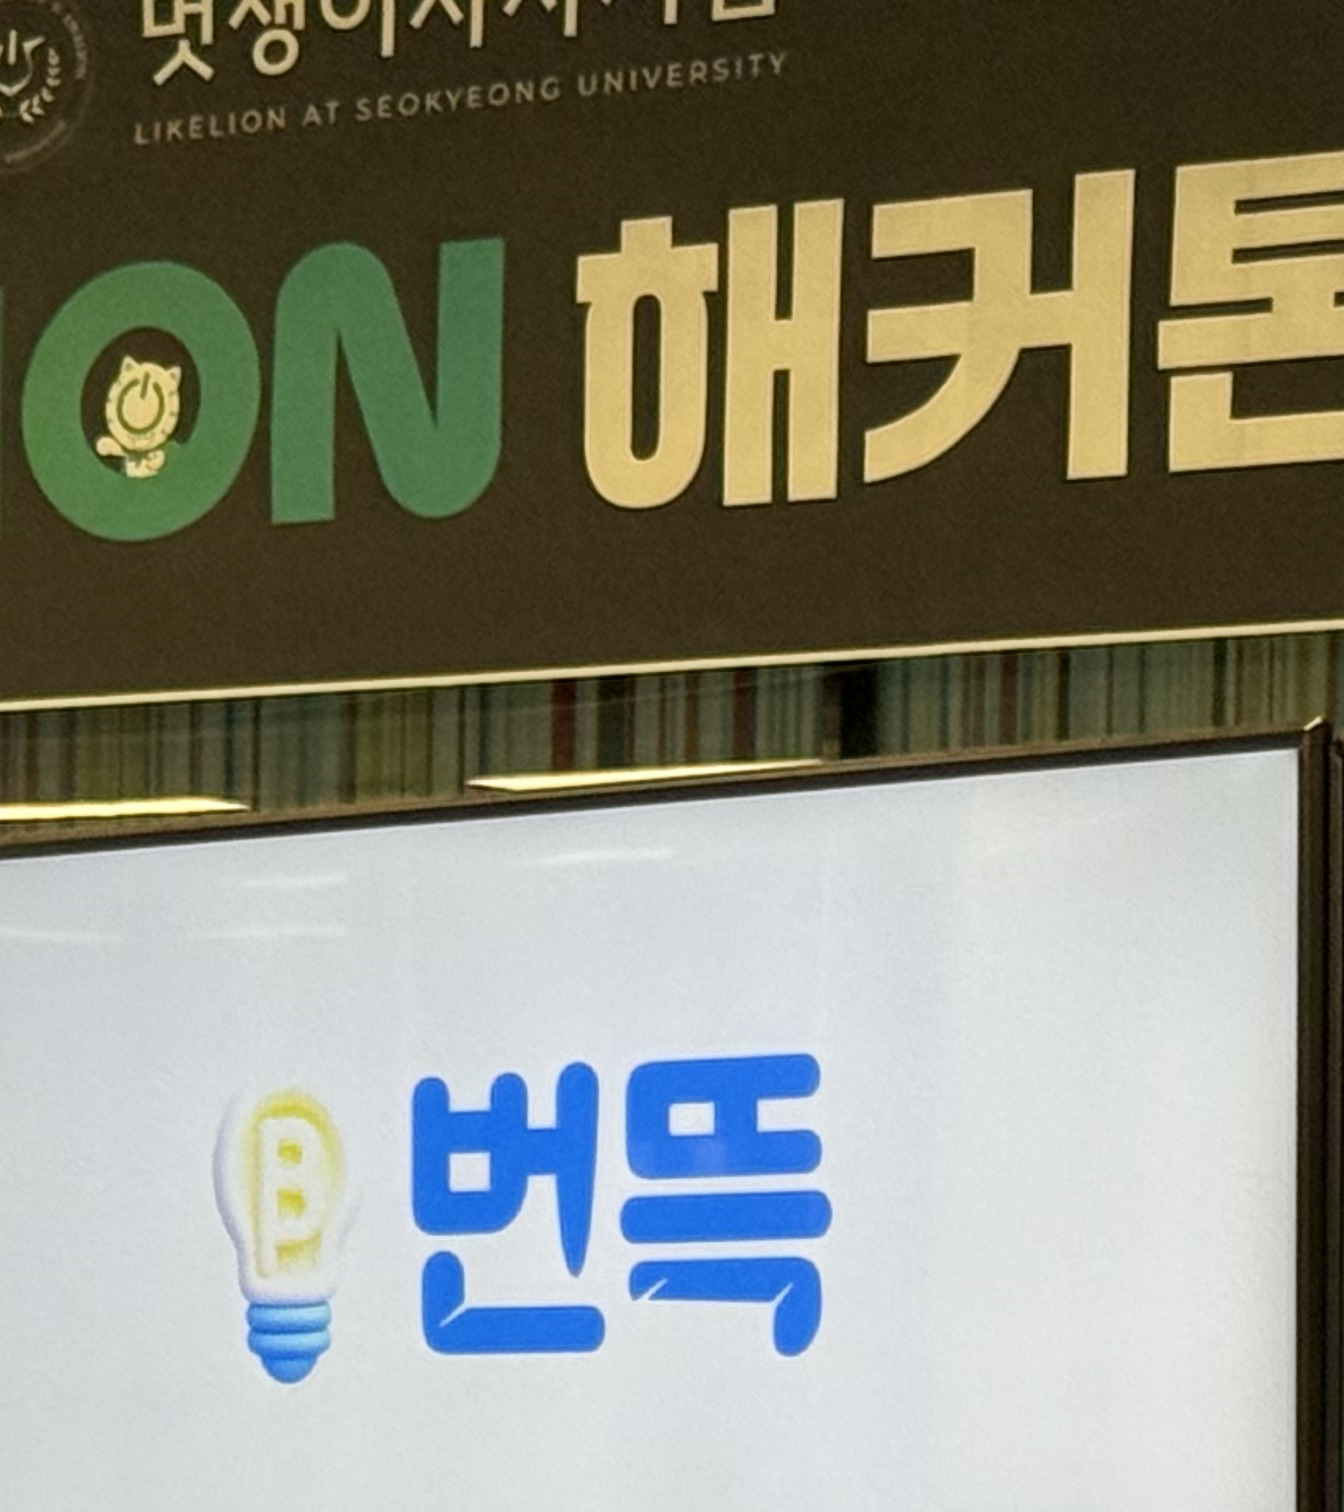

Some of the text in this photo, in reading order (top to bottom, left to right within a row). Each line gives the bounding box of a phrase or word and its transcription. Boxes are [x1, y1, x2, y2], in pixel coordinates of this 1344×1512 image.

[134, 50, 787, 145] LIKELION AT SEOKYEONG UNIVERSITY
[576, 150, 1344, 510] 해커톤
[411, 1052, 832, 1358] 번뜩
